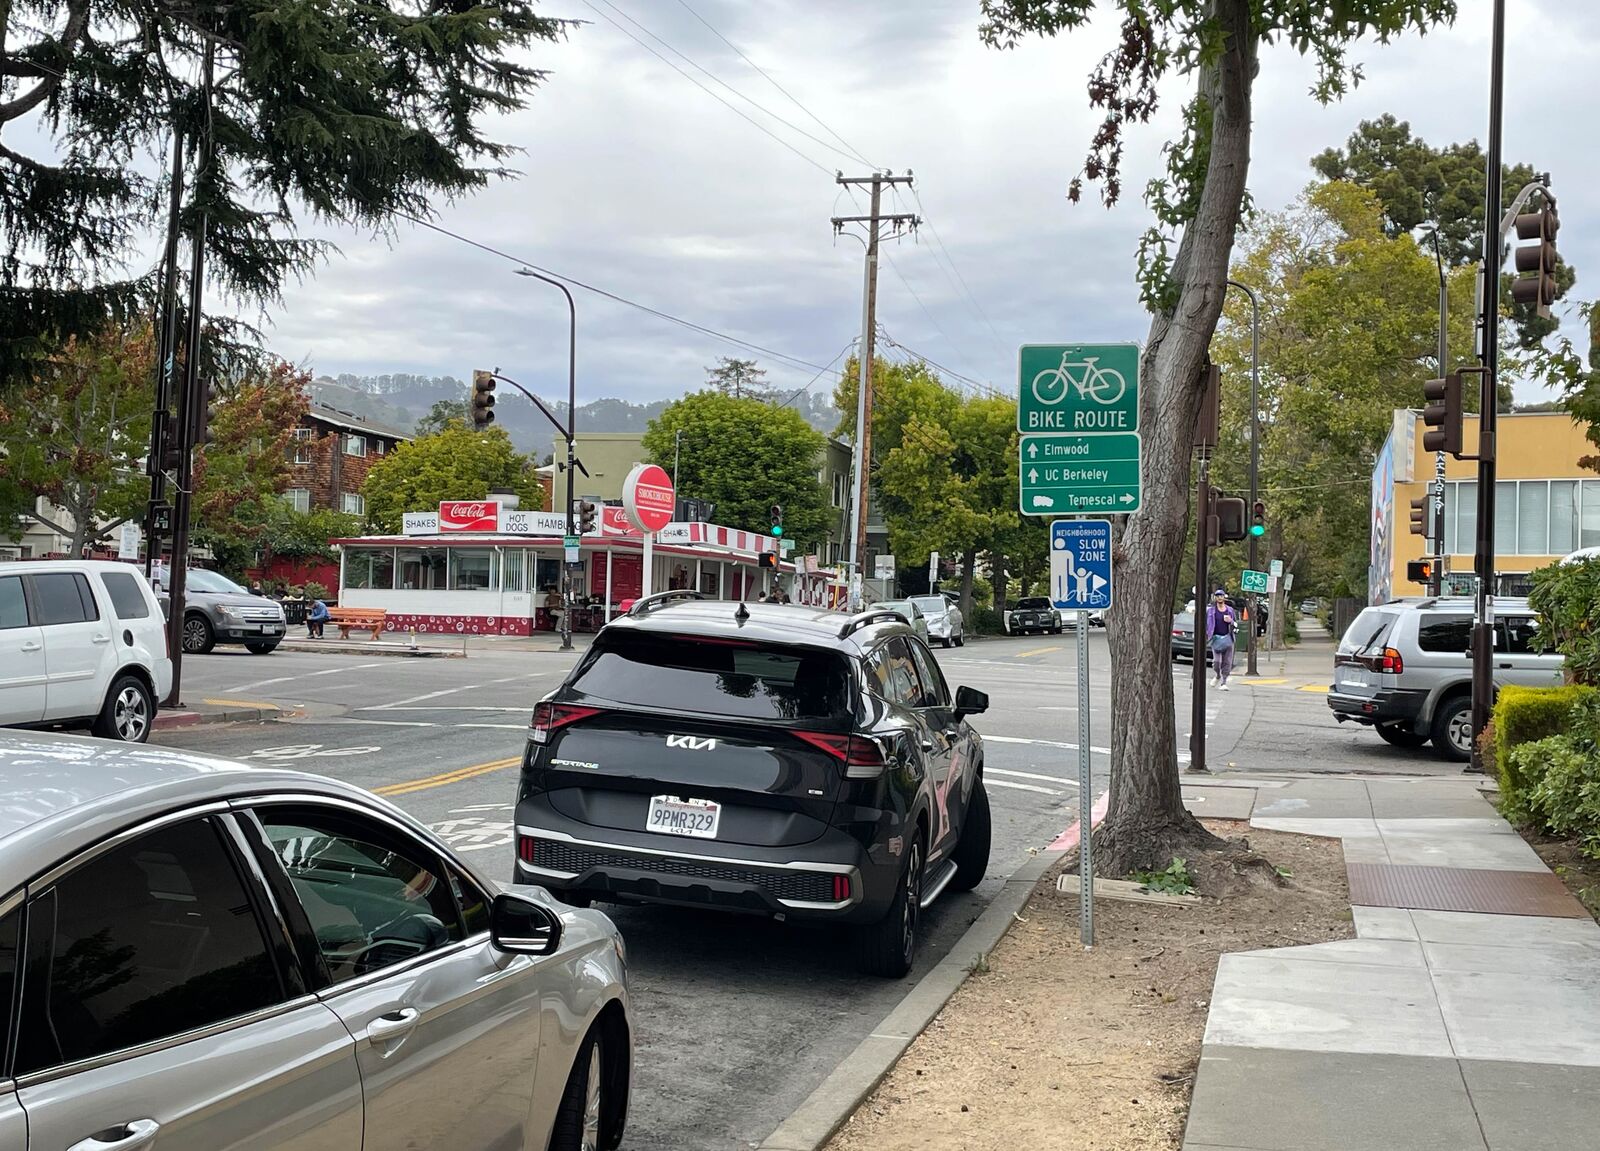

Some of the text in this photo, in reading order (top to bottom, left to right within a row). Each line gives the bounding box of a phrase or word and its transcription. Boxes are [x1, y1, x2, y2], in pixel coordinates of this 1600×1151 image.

[1029, 411, 1127, 428] BIKE ROUTE
[1044, 443, 1089, 456] Elmwood
[1045, 468, 1108, 483] UC Berkeley
[1068, 494, 1116, 506] Temescal
[405, 518, 437, 529] SHAKES
[509, 514, 526, 523] HOT
[505, 522, 529, 532] DOGS
[1056, 529, 1106, 537] NEIGHBORHOOD
[1079, 538, 1106, 550] SLOW
[1079, 550, 1106, 562] ZONE
[666, 734, 716, 751] KIA
[550, 758, 600, 769] SPORTAGE
[653, 809, 713, 832] 9PMR329
